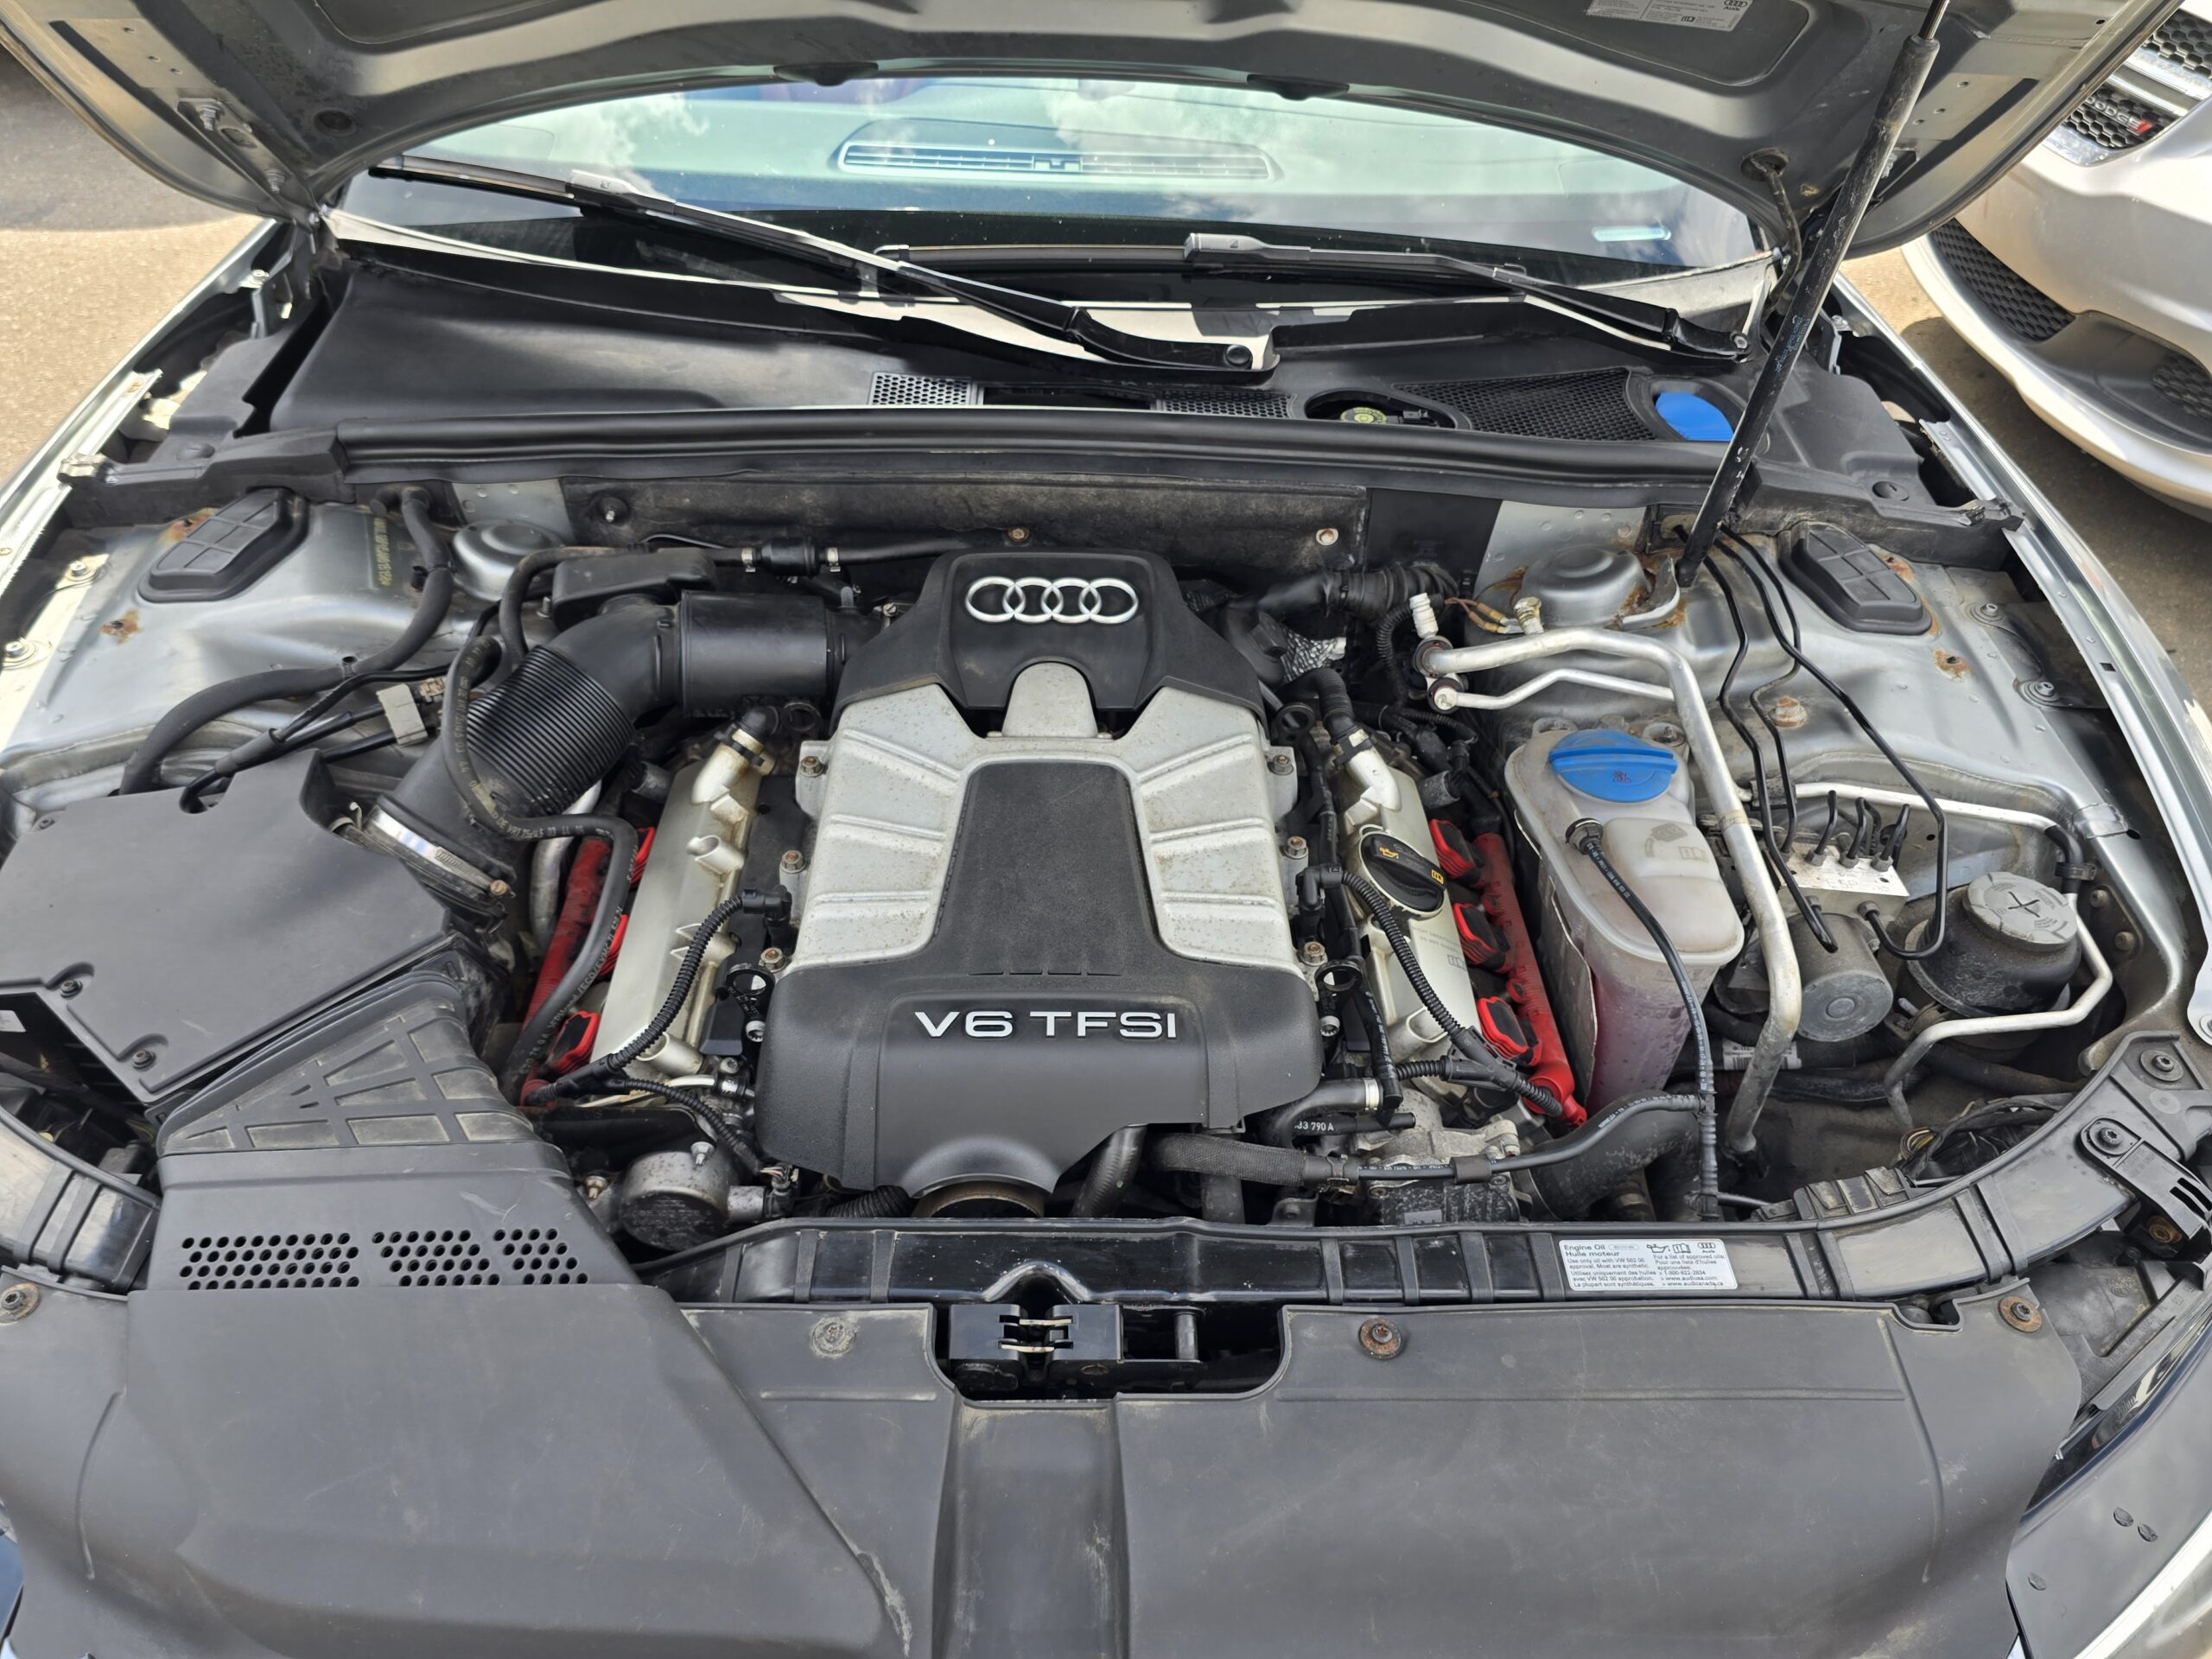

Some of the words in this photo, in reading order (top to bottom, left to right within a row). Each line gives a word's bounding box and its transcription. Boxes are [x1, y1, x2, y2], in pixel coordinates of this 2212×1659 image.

[2085, 96, 2142, 130] DODGE
[914, 1010, 1014, 1038] V6
[1029, 1010, 1177, 1039] TFSI
[1294, 1121, 1309, 1129] 33
[1311, 1122, 1326, 1131] 790
[1327, 1122, 1334, 1131] A
